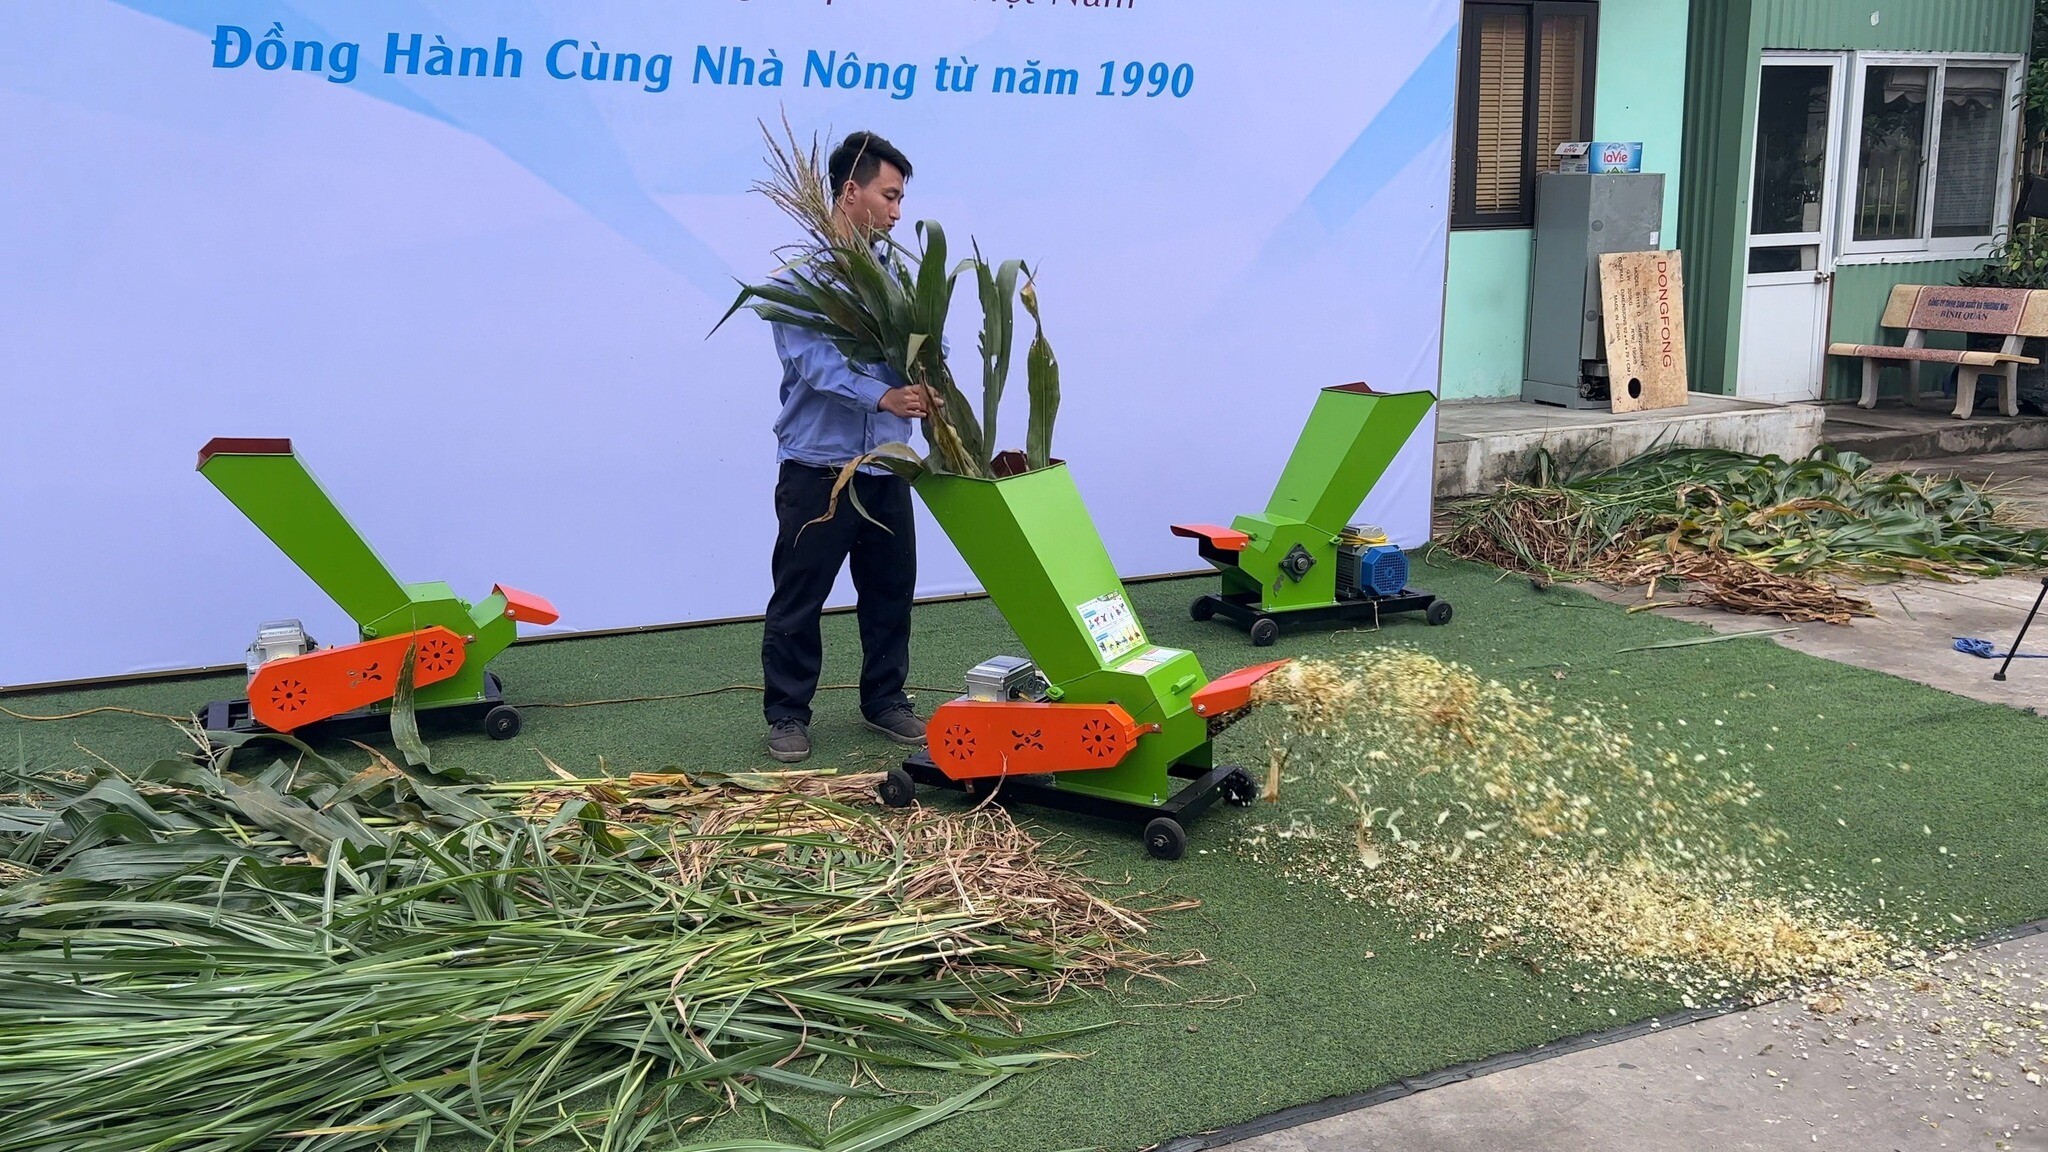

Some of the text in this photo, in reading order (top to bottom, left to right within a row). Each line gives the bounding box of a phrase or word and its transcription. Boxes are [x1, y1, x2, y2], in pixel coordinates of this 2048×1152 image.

[212, 22, 1193, 99] Đồng Hành Cùng Nhà Nông từ năm 1990
[1603, 151, 1628, 163] laVie
[1657, 261, 1672, 368] DONGFONG
